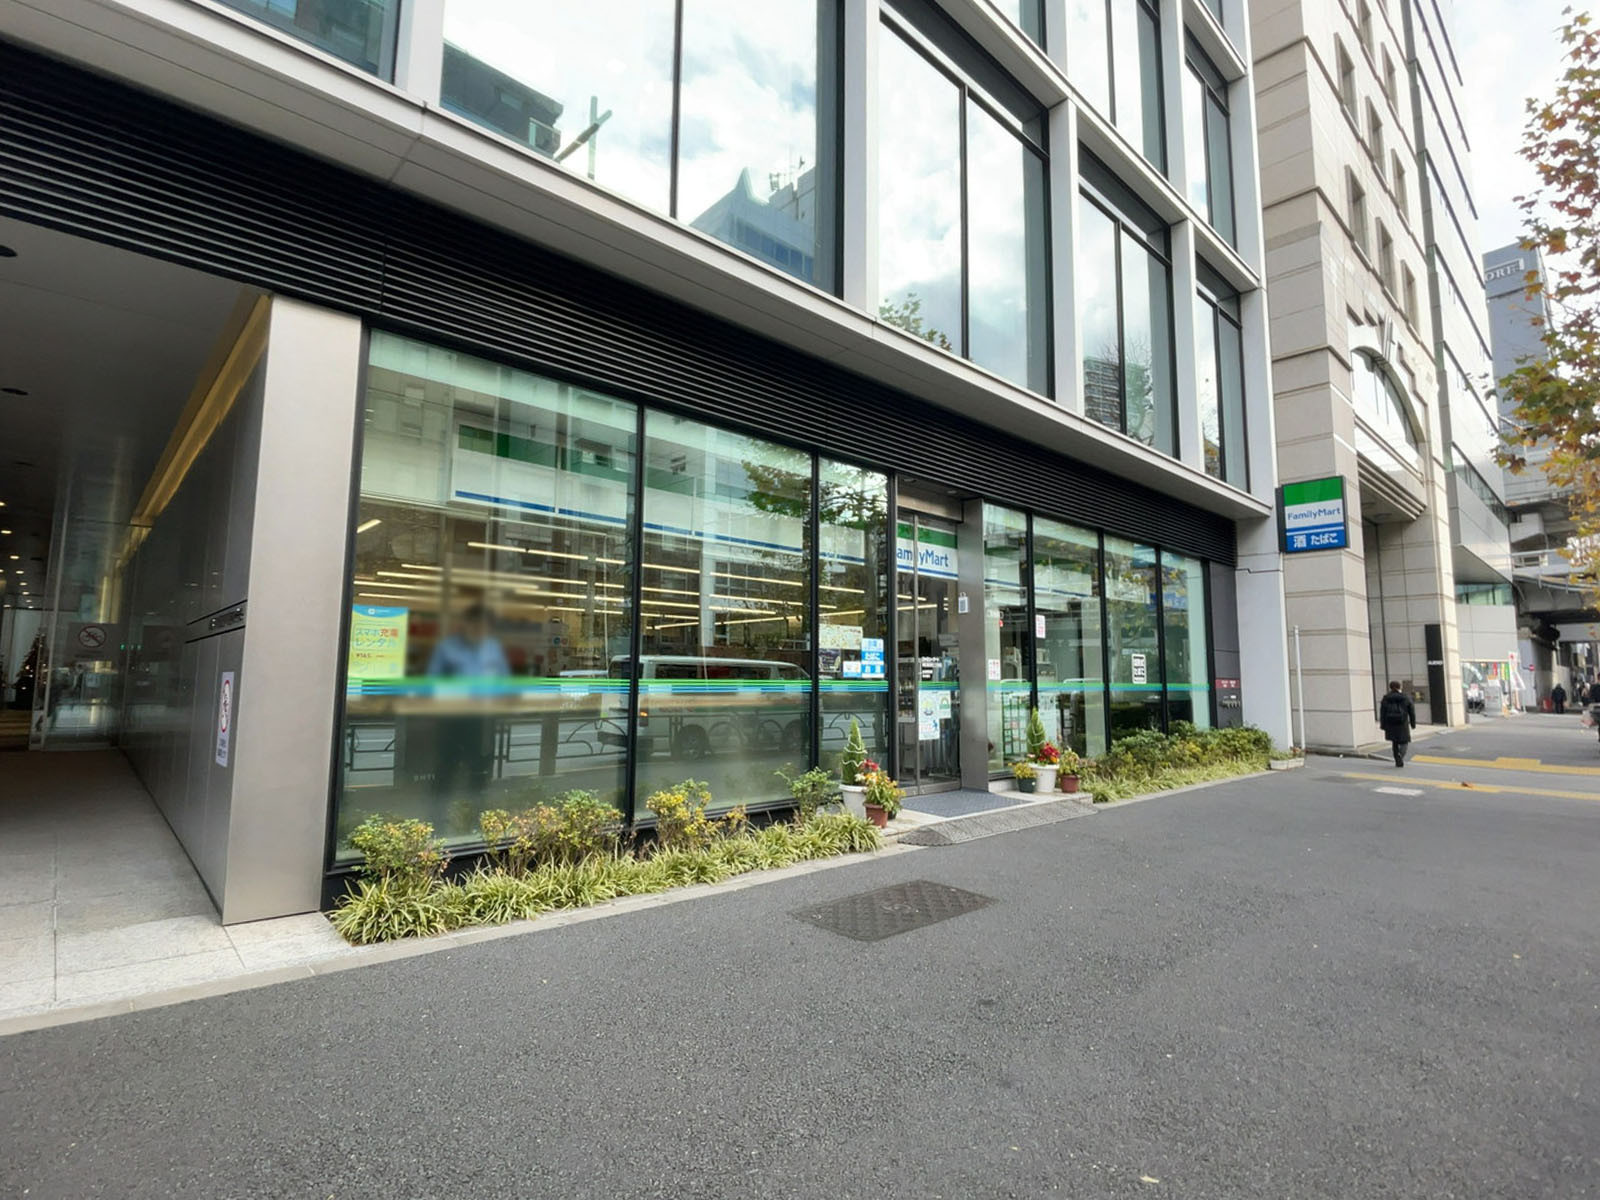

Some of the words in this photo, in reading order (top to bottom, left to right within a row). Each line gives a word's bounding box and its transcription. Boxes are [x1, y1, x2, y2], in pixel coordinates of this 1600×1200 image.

[1287, 507, 1341, 520] FamilyMart
[1294, 535, 1307, 548] 酒
[1311, 532, 1338, 546] たばこ
[896, 547, 949, 567] amyMart
